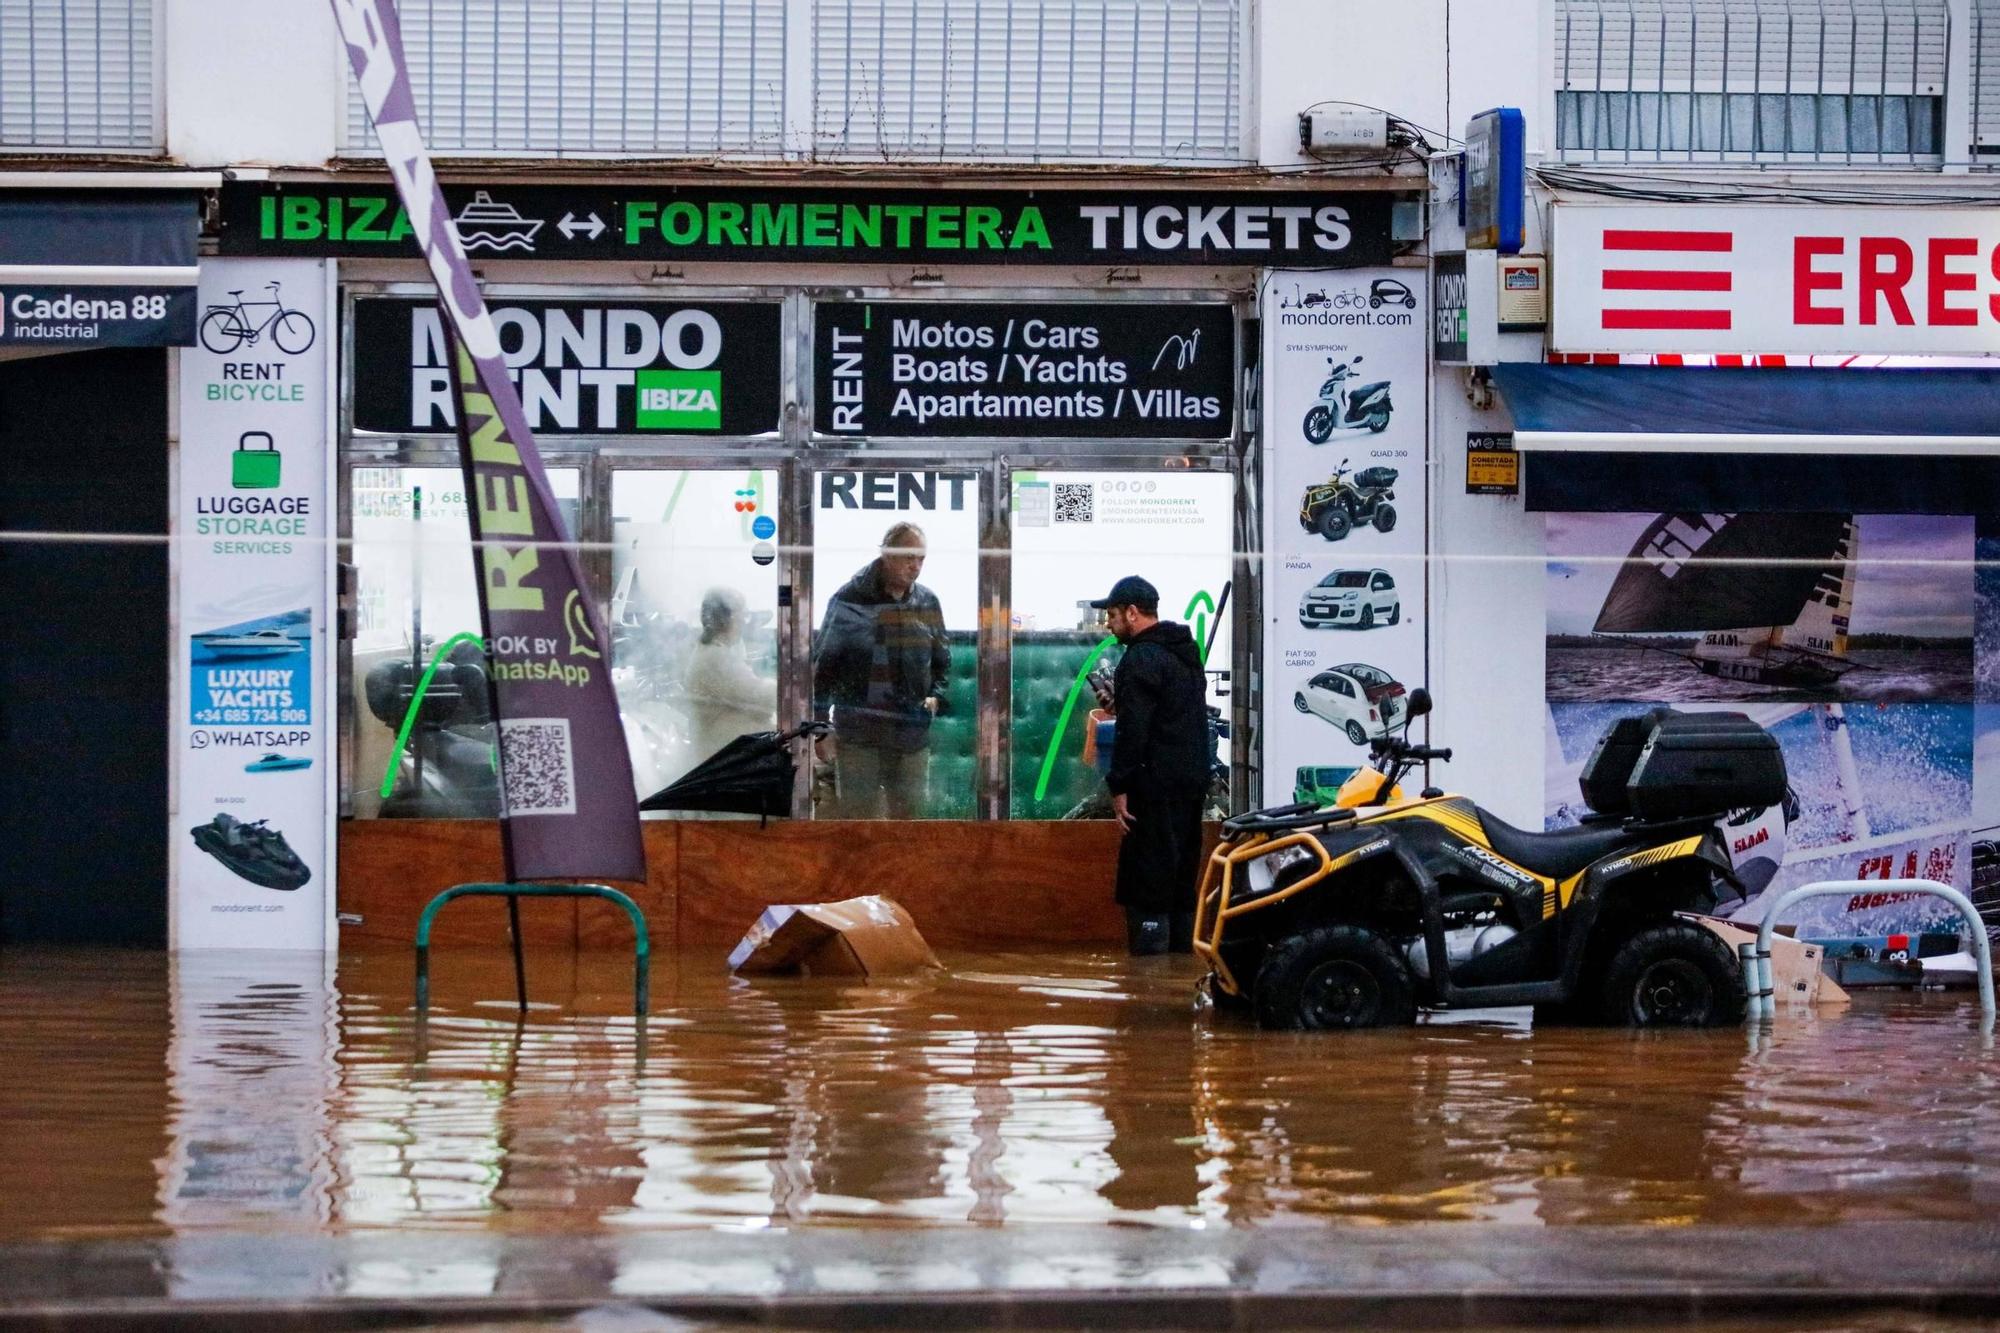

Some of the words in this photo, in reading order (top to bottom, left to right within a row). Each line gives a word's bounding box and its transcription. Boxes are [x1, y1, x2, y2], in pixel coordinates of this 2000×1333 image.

[624, 201, 1052, 249] FORMENTERA
[1080, 204, 1352, 251] TICKETS
[1793, 236, 2000, 326] ERE
[1436, 273, 1467, 309] MONDO
[11, 294, 126, 320] Cadena
[131, 295, 167, 320] 88
[1281, 311, 1412, 325] mondorent.com
[1436, 309, 1459, 343] RENT
[14, 323, 98, 338] industrial
[893, 319, 994, 348] Motos
[1024, 319, 1099, 349] Cars
[223, 363, 285, 380] RENT
[893, 353, 987, 382] Boats
[1016, 353, 1127, 383] Yachts
[832, 326, 863, 430] RENT
[207, 384, 304, 401] BICYCLE
[412, 367, 635, 428] RNT
[640, 388, 717, 411] IBIZA
[891, 388, 1103, 424] Apartaments
[1133, 388, 1220, 419] Villas
[1371, 450, 1393, 458] QUAD
[1394, 450, 1408, 458] 300
[820, 471, 977, 511] RENT
[197, 497, 309, 514] LUGGAGE
[197, 518, 306, 535] STORAGE
[213, 542, 292, 554] SERVICES
[534, 638, 558, 655] BY
[1705, 633, 1739, 647] SLAM
[1807, 636, 1834, 651] SLAM
[1285, 650, 1302, 658] FIAT
[1303, 650, 1316, 658] 500
[1285, 659, 1315, 667] CABRIO
[207, 670, 293, 687] LUXURY
[487, 658, 590, 687] hatsApp
[208, 690, 293, 707] YACHTS
[195, 710, 219, 722] +34
[224, 710, 251, 722] 685
[253, 710, 278, 722] 734
[213, 732, 311, 746] WHATSAPP
[1734, 827, 1769, 854] SLAM
[1601, 858, 1631, 873] KYMCO
